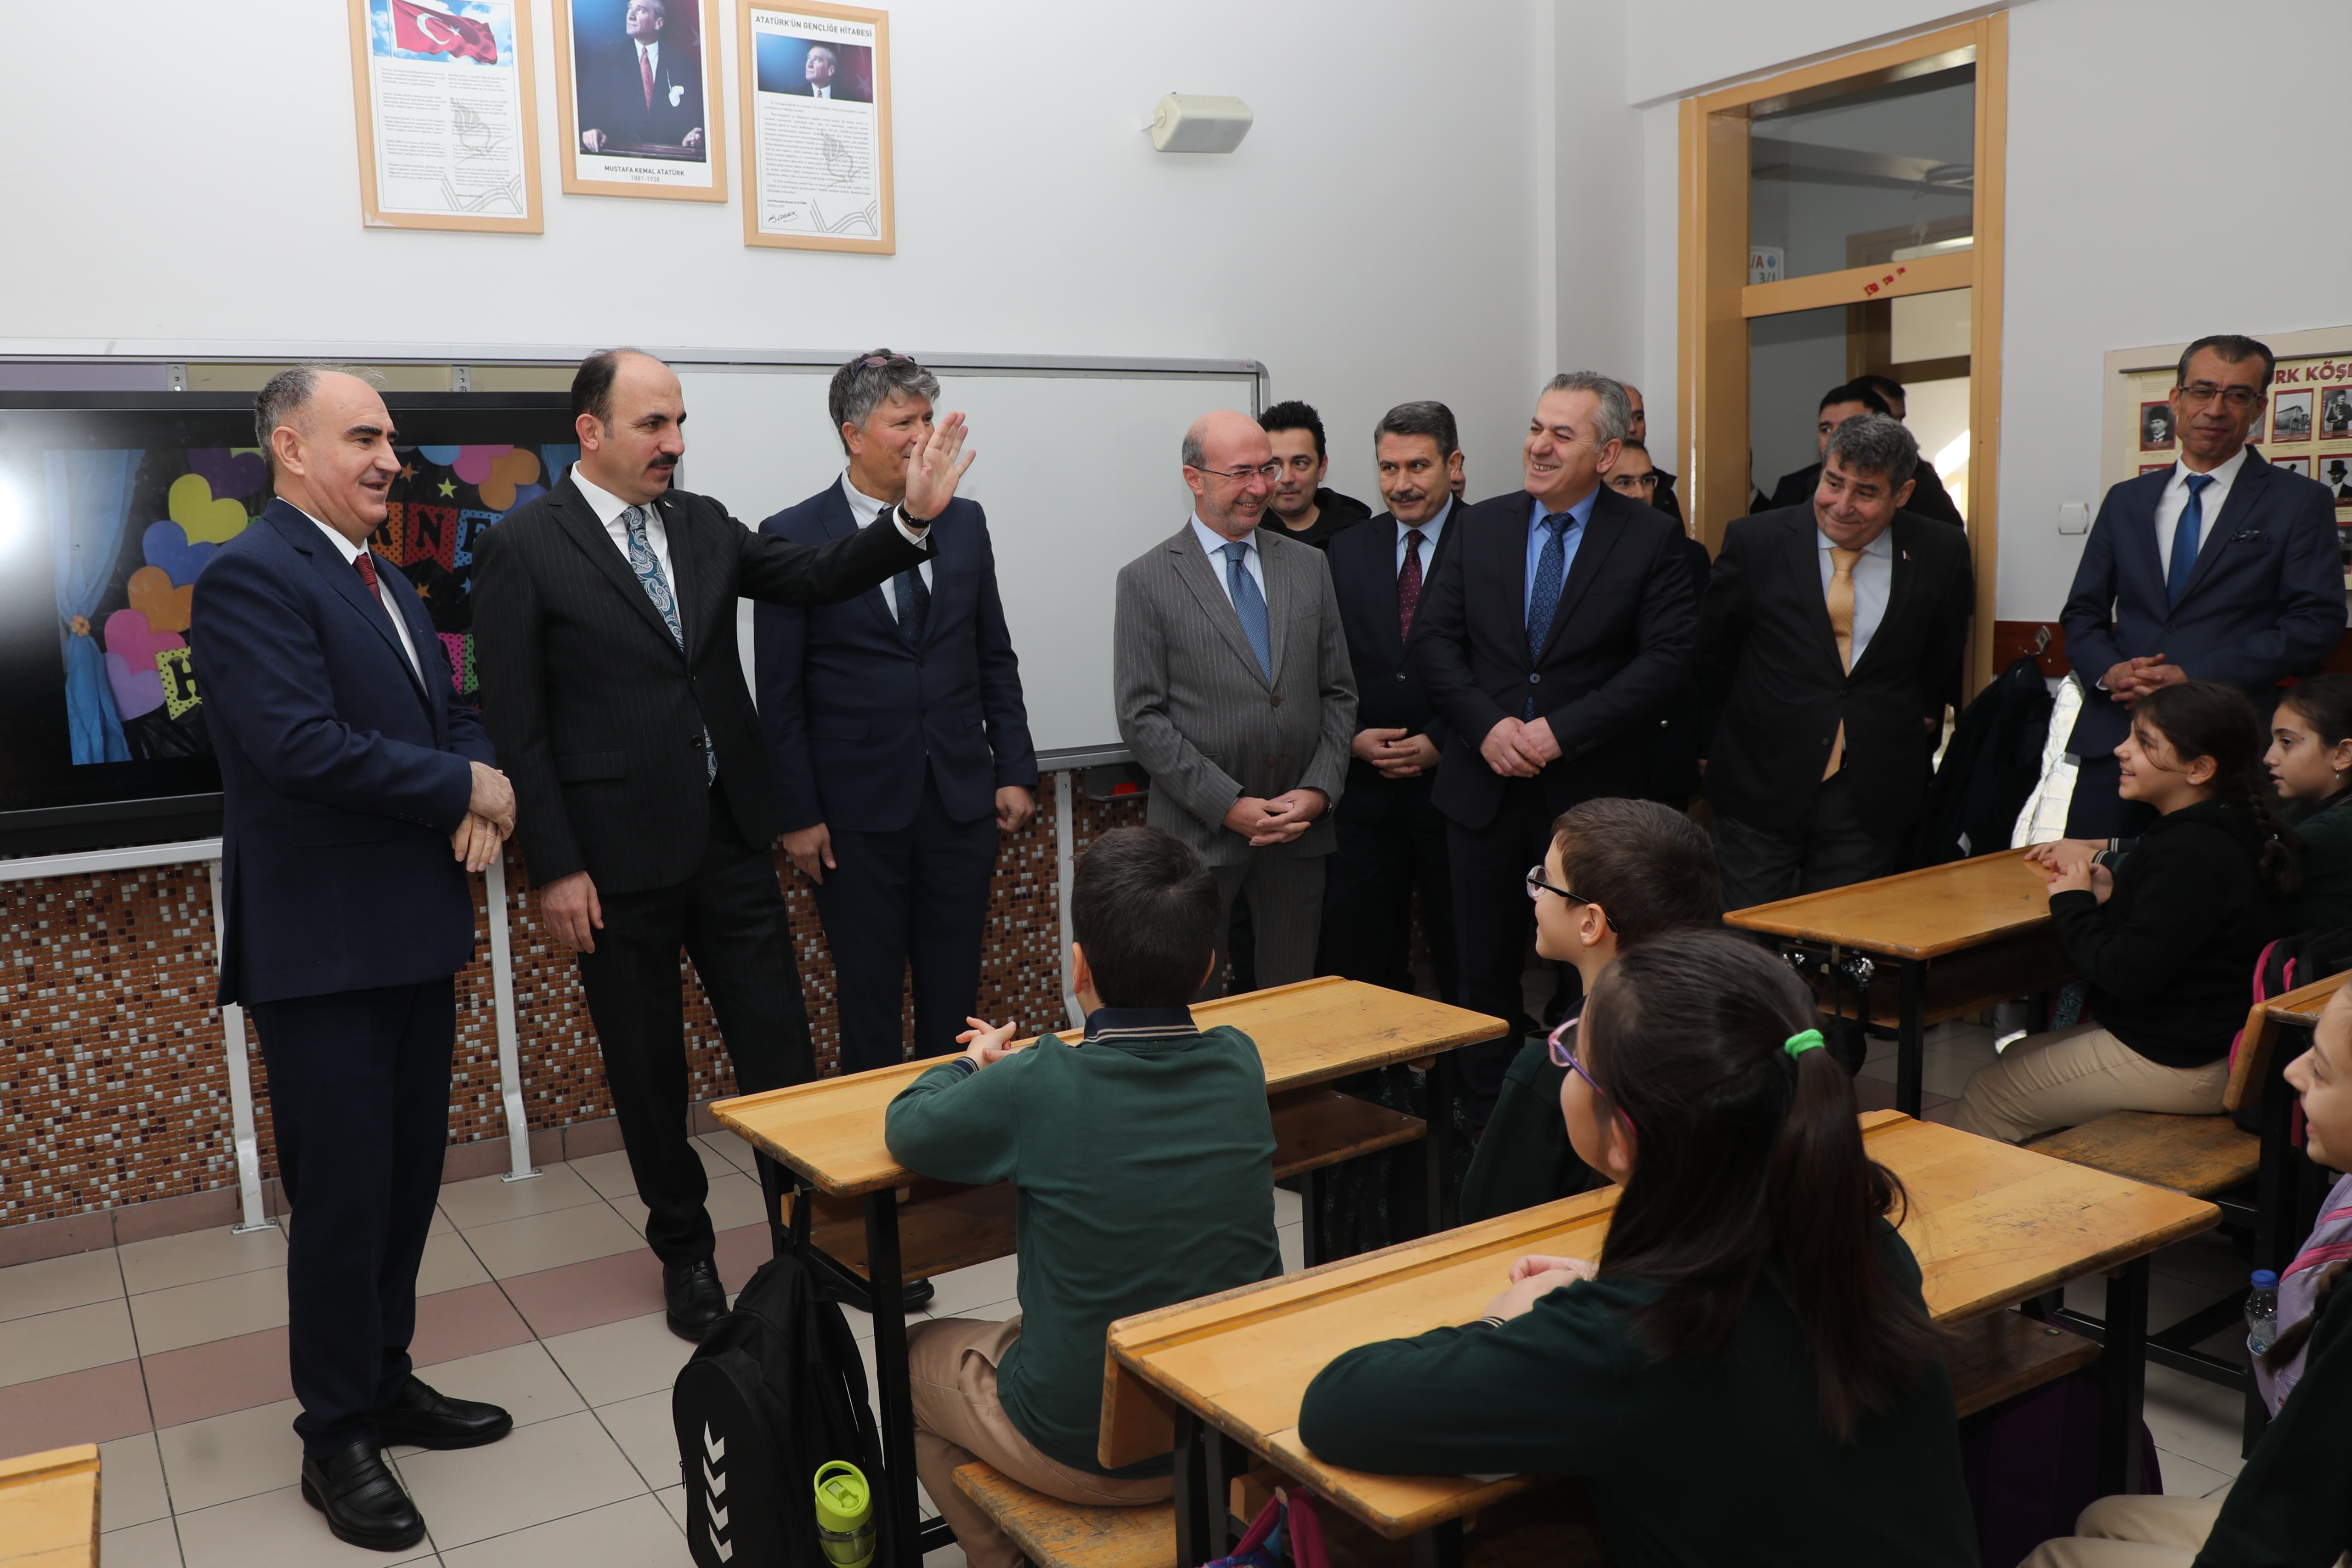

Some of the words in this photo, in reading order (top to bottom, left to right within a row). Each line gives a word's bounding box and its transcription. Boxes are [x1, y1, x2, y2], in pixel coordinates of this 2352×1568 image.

[756, 15, 801, 28] ATATÜRK'ÜN
[803, 22, 838, 33] GENÇLİĞE
[840, 26, 872, 37] HİTABESİ
